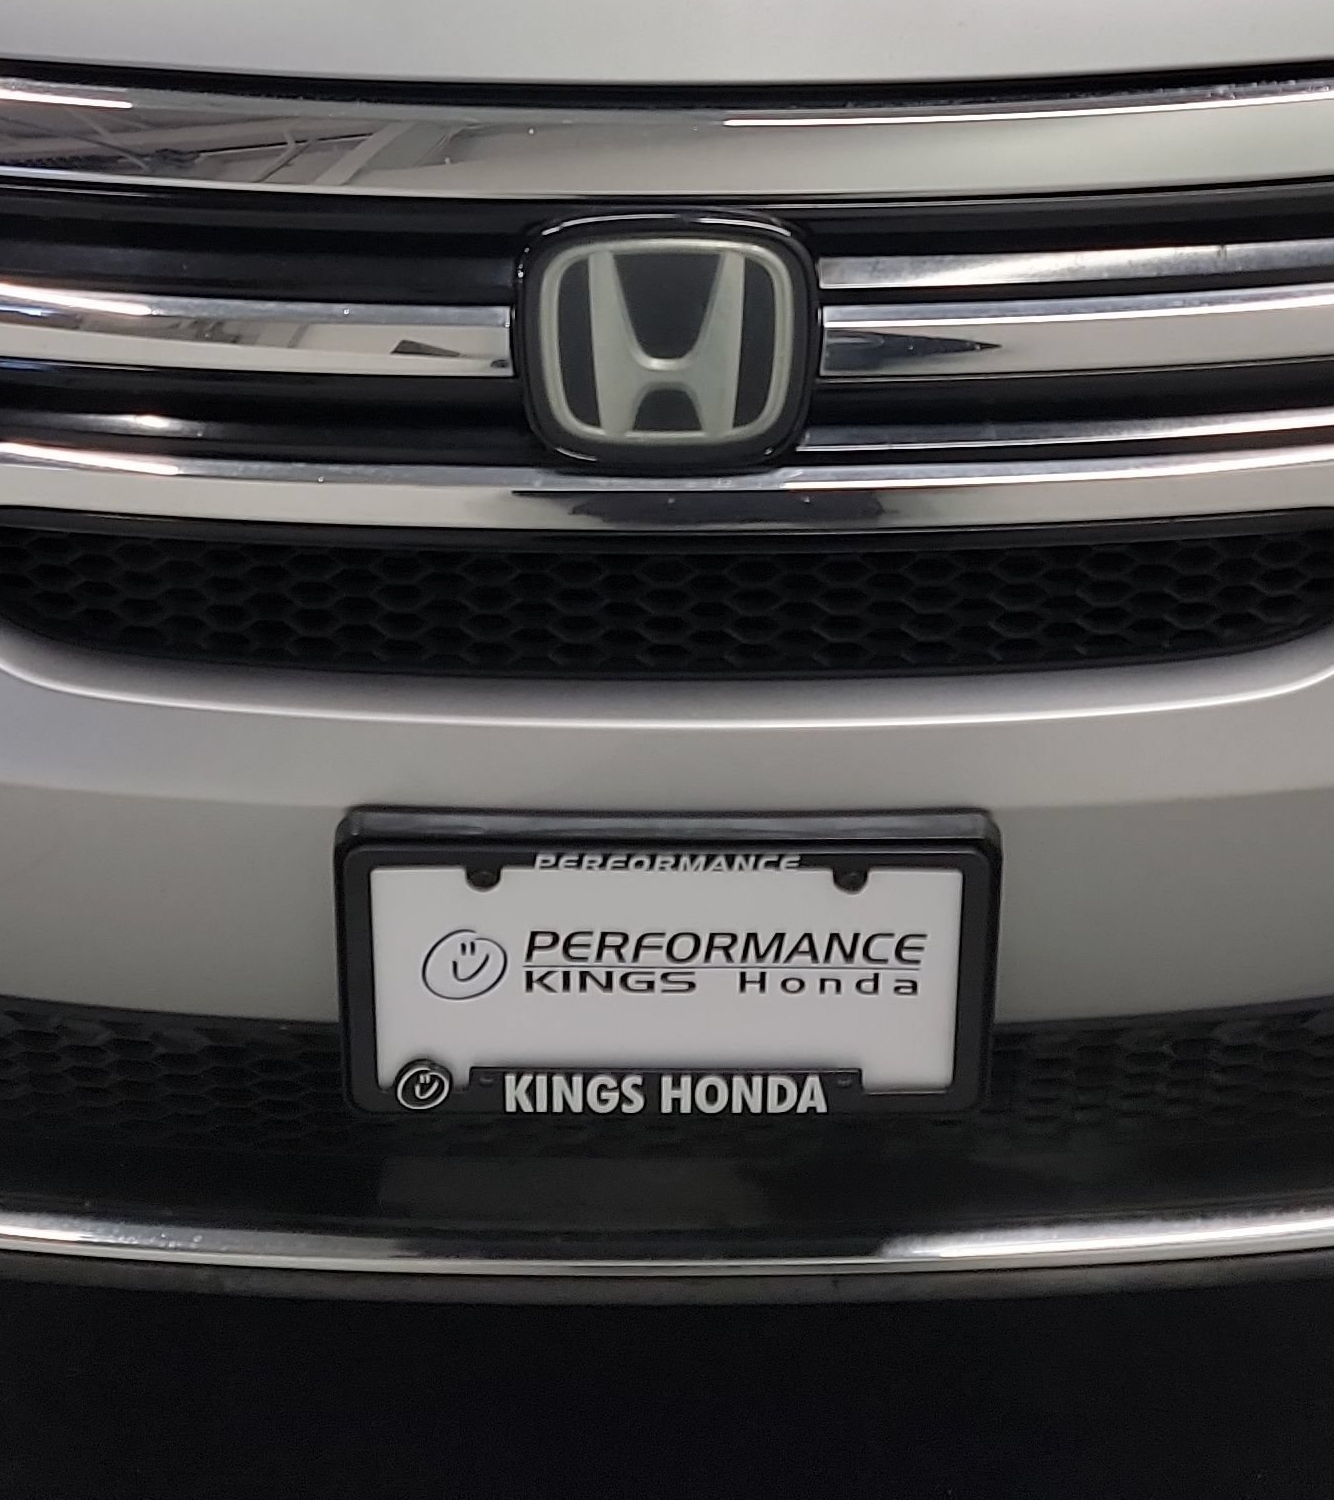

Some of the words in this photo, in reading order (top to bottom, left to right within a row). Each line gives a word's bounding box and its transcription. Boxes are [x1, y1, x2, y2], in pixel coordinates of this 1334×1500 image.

[534, 853, 801, 872] PERFORMANCE
[524, 930, 928, 965] PERFORMANCE
[524, 970, 697, 994] KINGS
[738, 971, 920, 996] Honda
[504, 1074, 645, 1114] KINGS
[660, 1075, 828, 1114] HONDA
